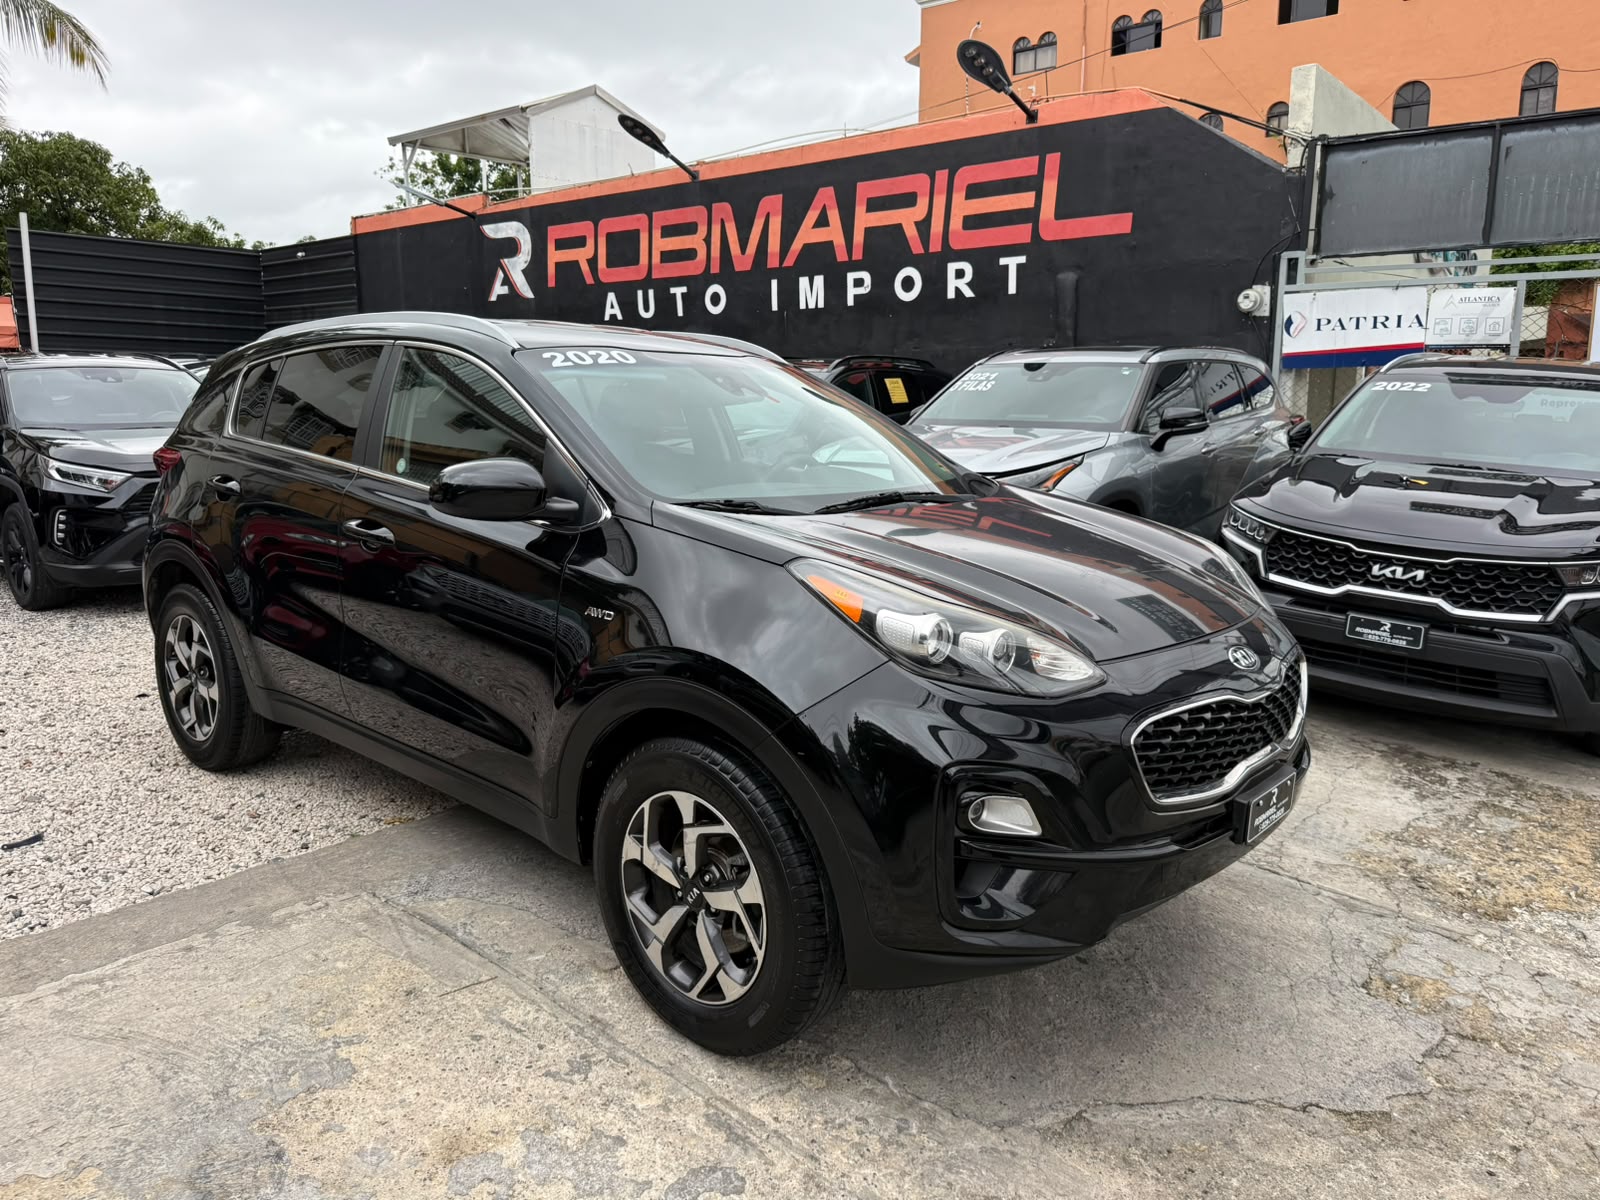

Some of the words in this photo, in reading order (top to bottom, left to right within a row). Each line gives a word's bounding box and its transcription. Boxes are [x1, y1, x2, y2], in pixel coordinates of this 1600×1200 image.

[547, 152, 1133, 288] ROBMARIEL
[604, 284, 727, 321] AUTO
[771, 255, 1027, 312] IMPORT
[1315, 313, 1424, 331] PATRIA
[542, 350, 637, 368] 2020
[957, 380, 996, 392] FILAS
[1371, 381, 1432, 392] 2022
[1371, 563, 1425, 581] KIA
[584, 606, 615, 620] AWD
[687, 887, 700, 904] KIA
